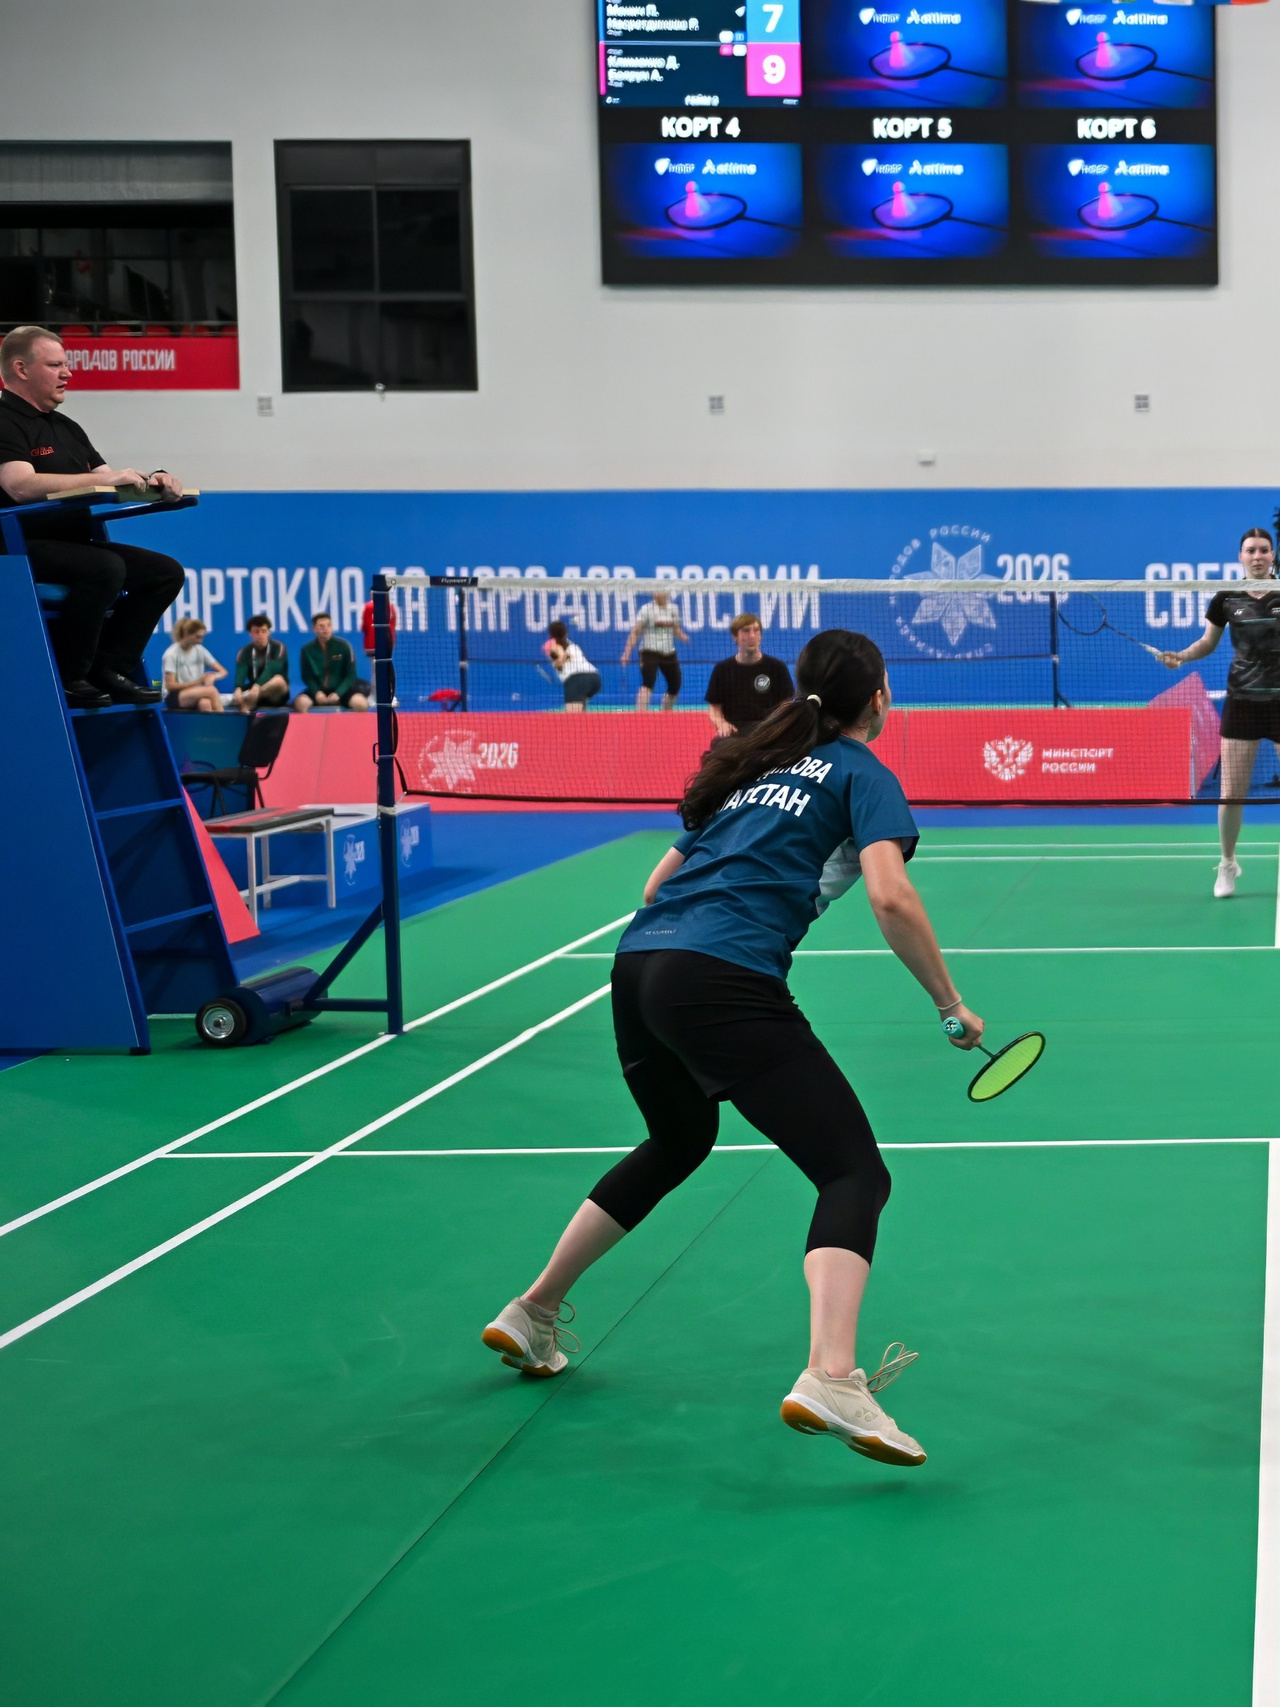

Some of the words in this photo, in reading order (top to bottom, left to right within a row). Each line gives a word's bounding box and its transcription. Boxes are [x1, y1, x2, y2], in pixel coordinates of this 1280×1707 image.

[762, 4, 784, 33] 7
[762, 54, 786, 84] 9
[661, 116, 722, 138] КОРТ
[725, 116, 741, 138] 4
[873, 117, 933, 139] КОРТ
[936, 117, 951, 139] 5
[1077, 117, 1137, 139] КОРТ
[1140, 117, 1156, 139] 6
[66, 349, 117, 371] АРОДОВ
[122, 349, 176, 371] РОССИИ
[929, 524, 992, 544] РОССИИ
[997, 552, 1070, 604] 2026
[477, 741, 519, 769] 2026
[1042, 747, 1114, 759] МИНСПОРТ
[1041, 762, 1096, 774] РОССИИ
